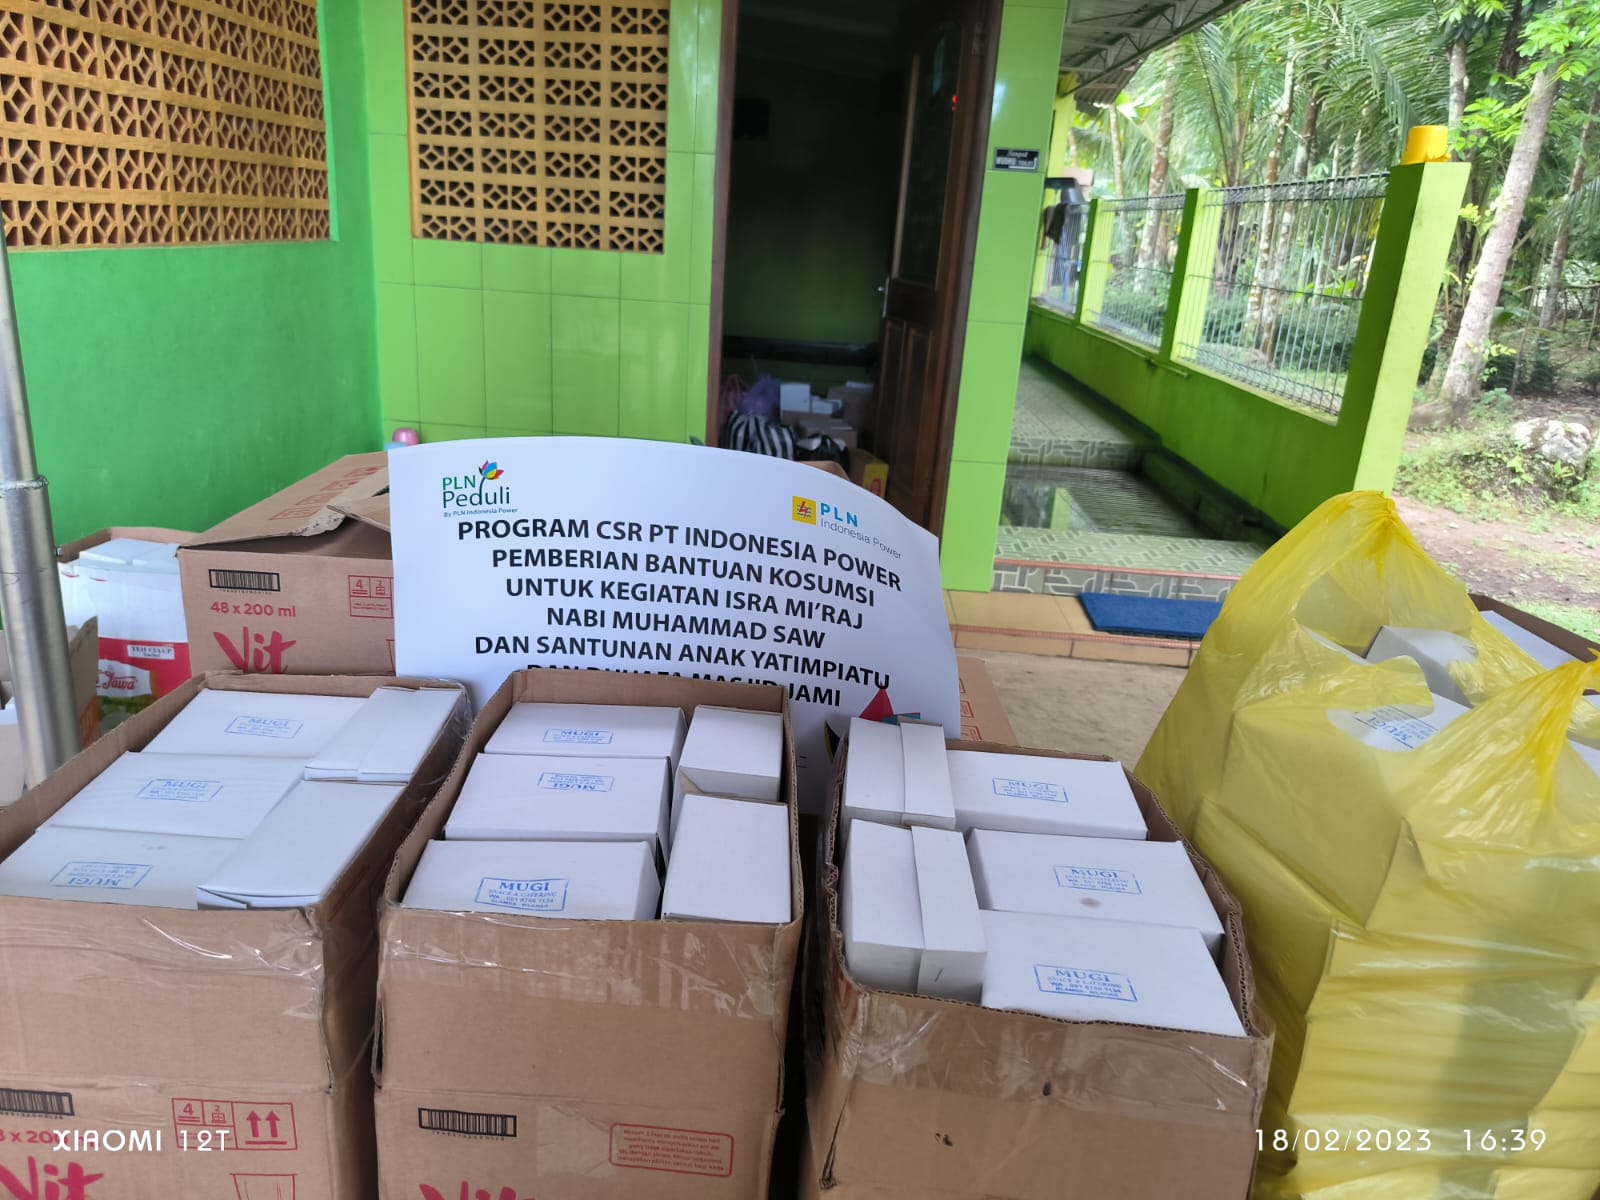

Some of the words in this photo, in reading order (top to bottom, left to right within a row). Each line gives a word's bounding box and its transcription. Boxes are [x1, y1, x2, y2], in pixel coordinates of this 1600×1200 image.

[443, 475, 476, 490] PLN
[443, 484, 510, 508] Peduli
[821, 502, 858, 527] PLN
[820, 518, 871, 544] Indonesia
[872, 537, 902, 559] Power
[458, 518, 589, 541] PROGRAM
[596, 520, 642, 542] CSR
[649, 524, 678, 544] PT
[685, 527, 817, 563] INDONESIA
[823, 548, 902, 592] POWER
[492, 548, 638, 571] PEMBERIAN
[646, 554, 762, 583] BANTUAN
[769, 567, 874, 607] KOSUMSI
[506, 578, 594, 598] UNTUK
[601, 581, 718, 606] KEGIATAN
[726, 590, 778, 614] ISRA
[210, 601, 230, 614] 48
[232, 605, 241, 614] x
[244, 603, 274, 616] 200
[278, 605, 296, 617] ml
[547, 607, 605, 628] NABI
[613, 611, 767, 640] MUHAMMAD
[773, 625, 825, 649] SAW
[213, 626, 296, 674] Vit
[475, 636, 529, 654] DAN
[537, 636, 672, 661] SANTUNAN
[678, 644, 745, 667] ANAK
[751, 650, 890, 690] YATIMPIATU
[249, 718, 289, 727] MUGI
[163, 781, 208, 789] MUGI
[1008, 781, 1049, 790] MUGI
[1071, 869, 1119, 878] MUGI
[68, 878, 121, 886] MUGI
[499, 882, 550, 891] MUGI
[1056, 969, 1110, 982] MUGI
[183, 1103, 193, 1115] 4
